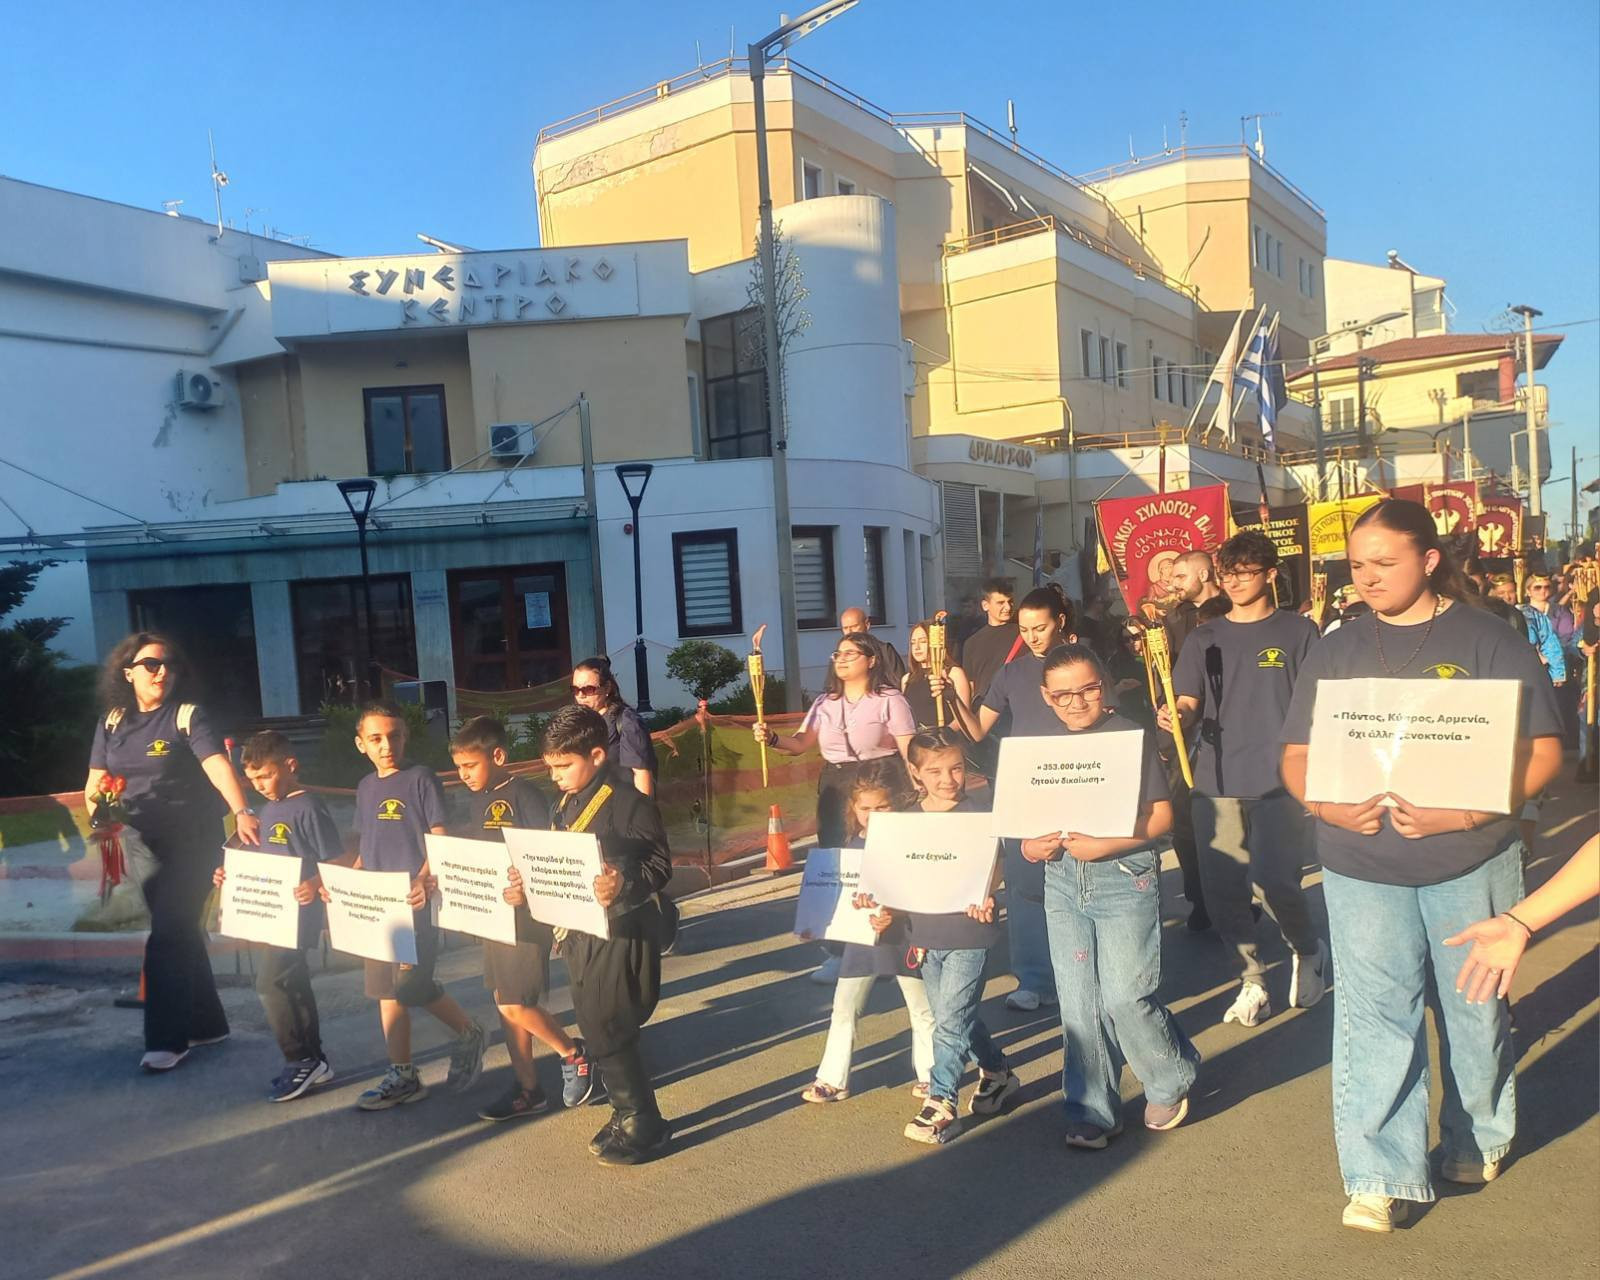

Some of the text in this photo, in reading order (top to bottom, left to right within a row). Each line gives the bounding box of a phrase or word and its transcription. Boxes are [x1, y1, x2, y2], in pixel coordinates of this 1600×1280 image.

[348, 255, 614, 296] ΣΥΝΕΔΡΙΑΚΟ
[400, 291, 568, 325] ΚΕΝΤΡΟ
[1135, 500, 1197, 523] ΣΥΛΛΟΓΟΣ
[1195, 513, 1218, 554] ΠΑΛΑ
[1341, 711, 1385, 723] Πόντος,
[1437, 713, 1490, 725] Αρμενία,
[1348, 729, 1366, 740] όχι
[1399, 731, 1463, 742] ενοκτονία
[1042, 763, 1074, 771] 353.000
[1076, 761, 1102, 771] ψυχές
[1030, 777, 1060, 786] ζητούν
[1060, 775, 1099, 785] δικαίωση
[925, 852, 952, 862] ξεχνώ!
